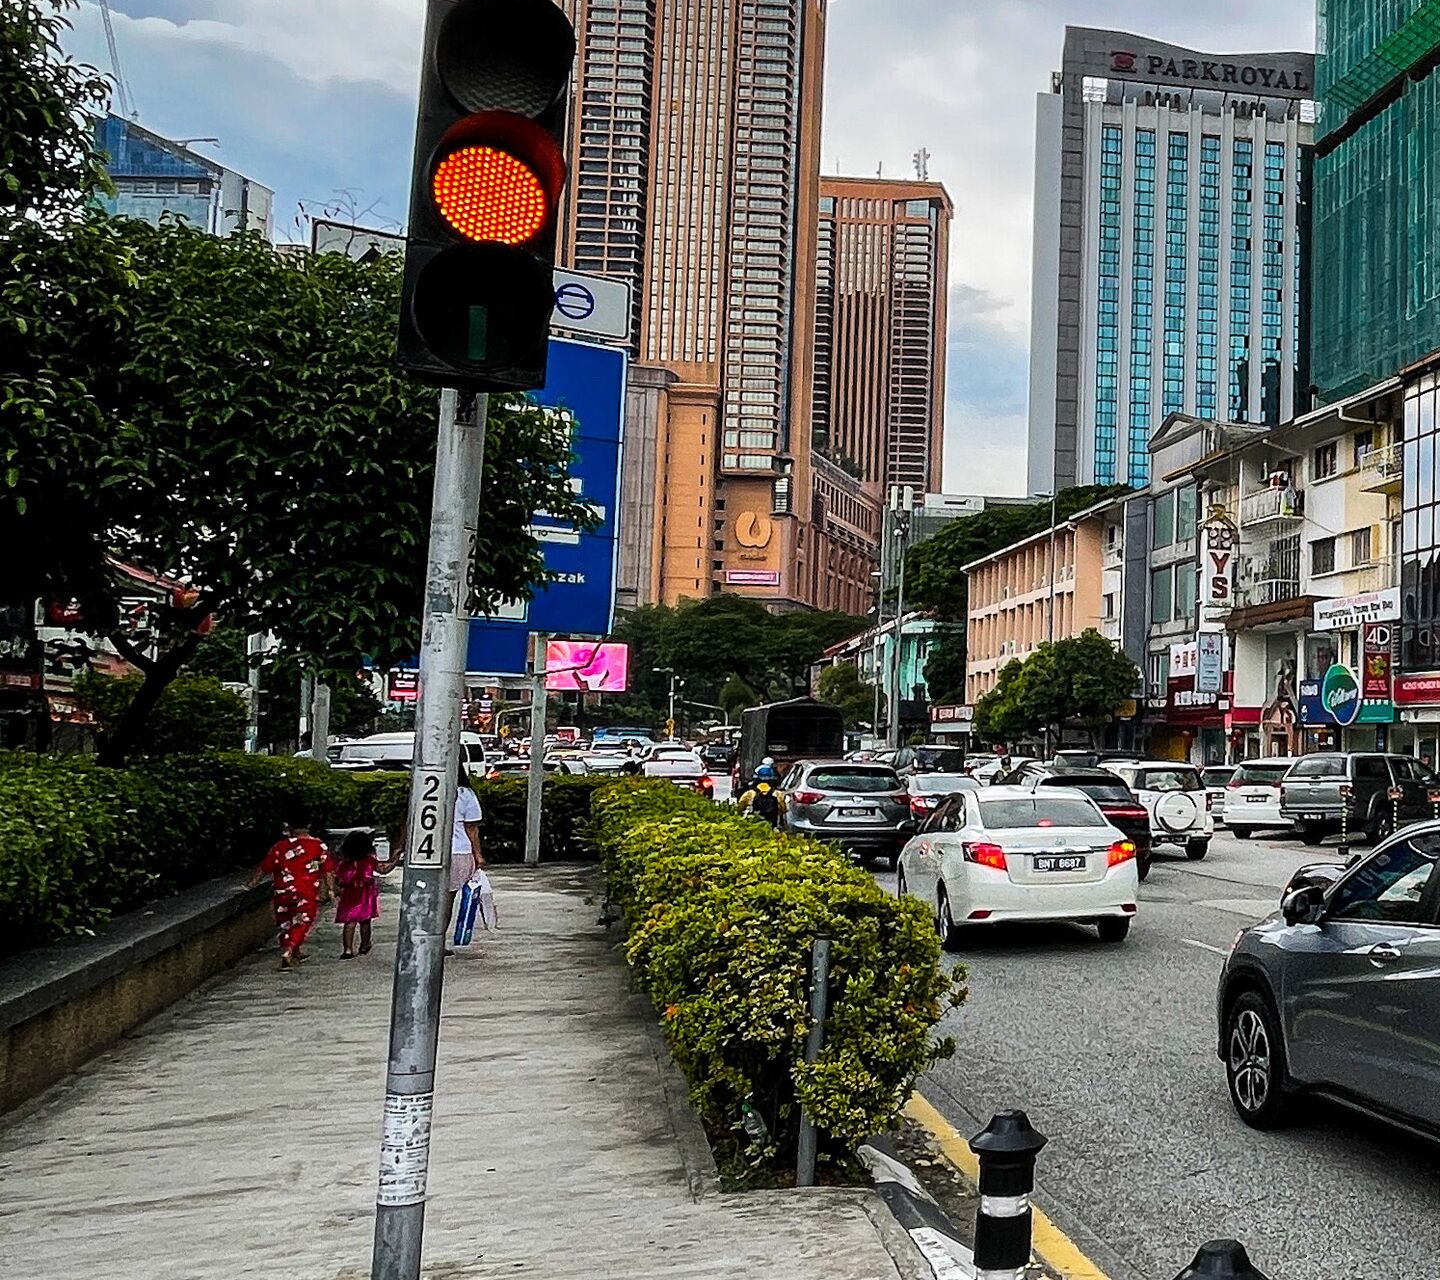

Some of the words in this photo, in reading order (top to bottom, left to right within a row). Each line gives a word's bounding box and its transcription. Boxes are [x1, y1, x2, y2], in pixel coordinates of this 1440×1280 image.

[1147, 55, 1308, 91] PARKROYAL
[1366, 626, 1390, 645] 4D
[417, 775, 441, 860] 264
